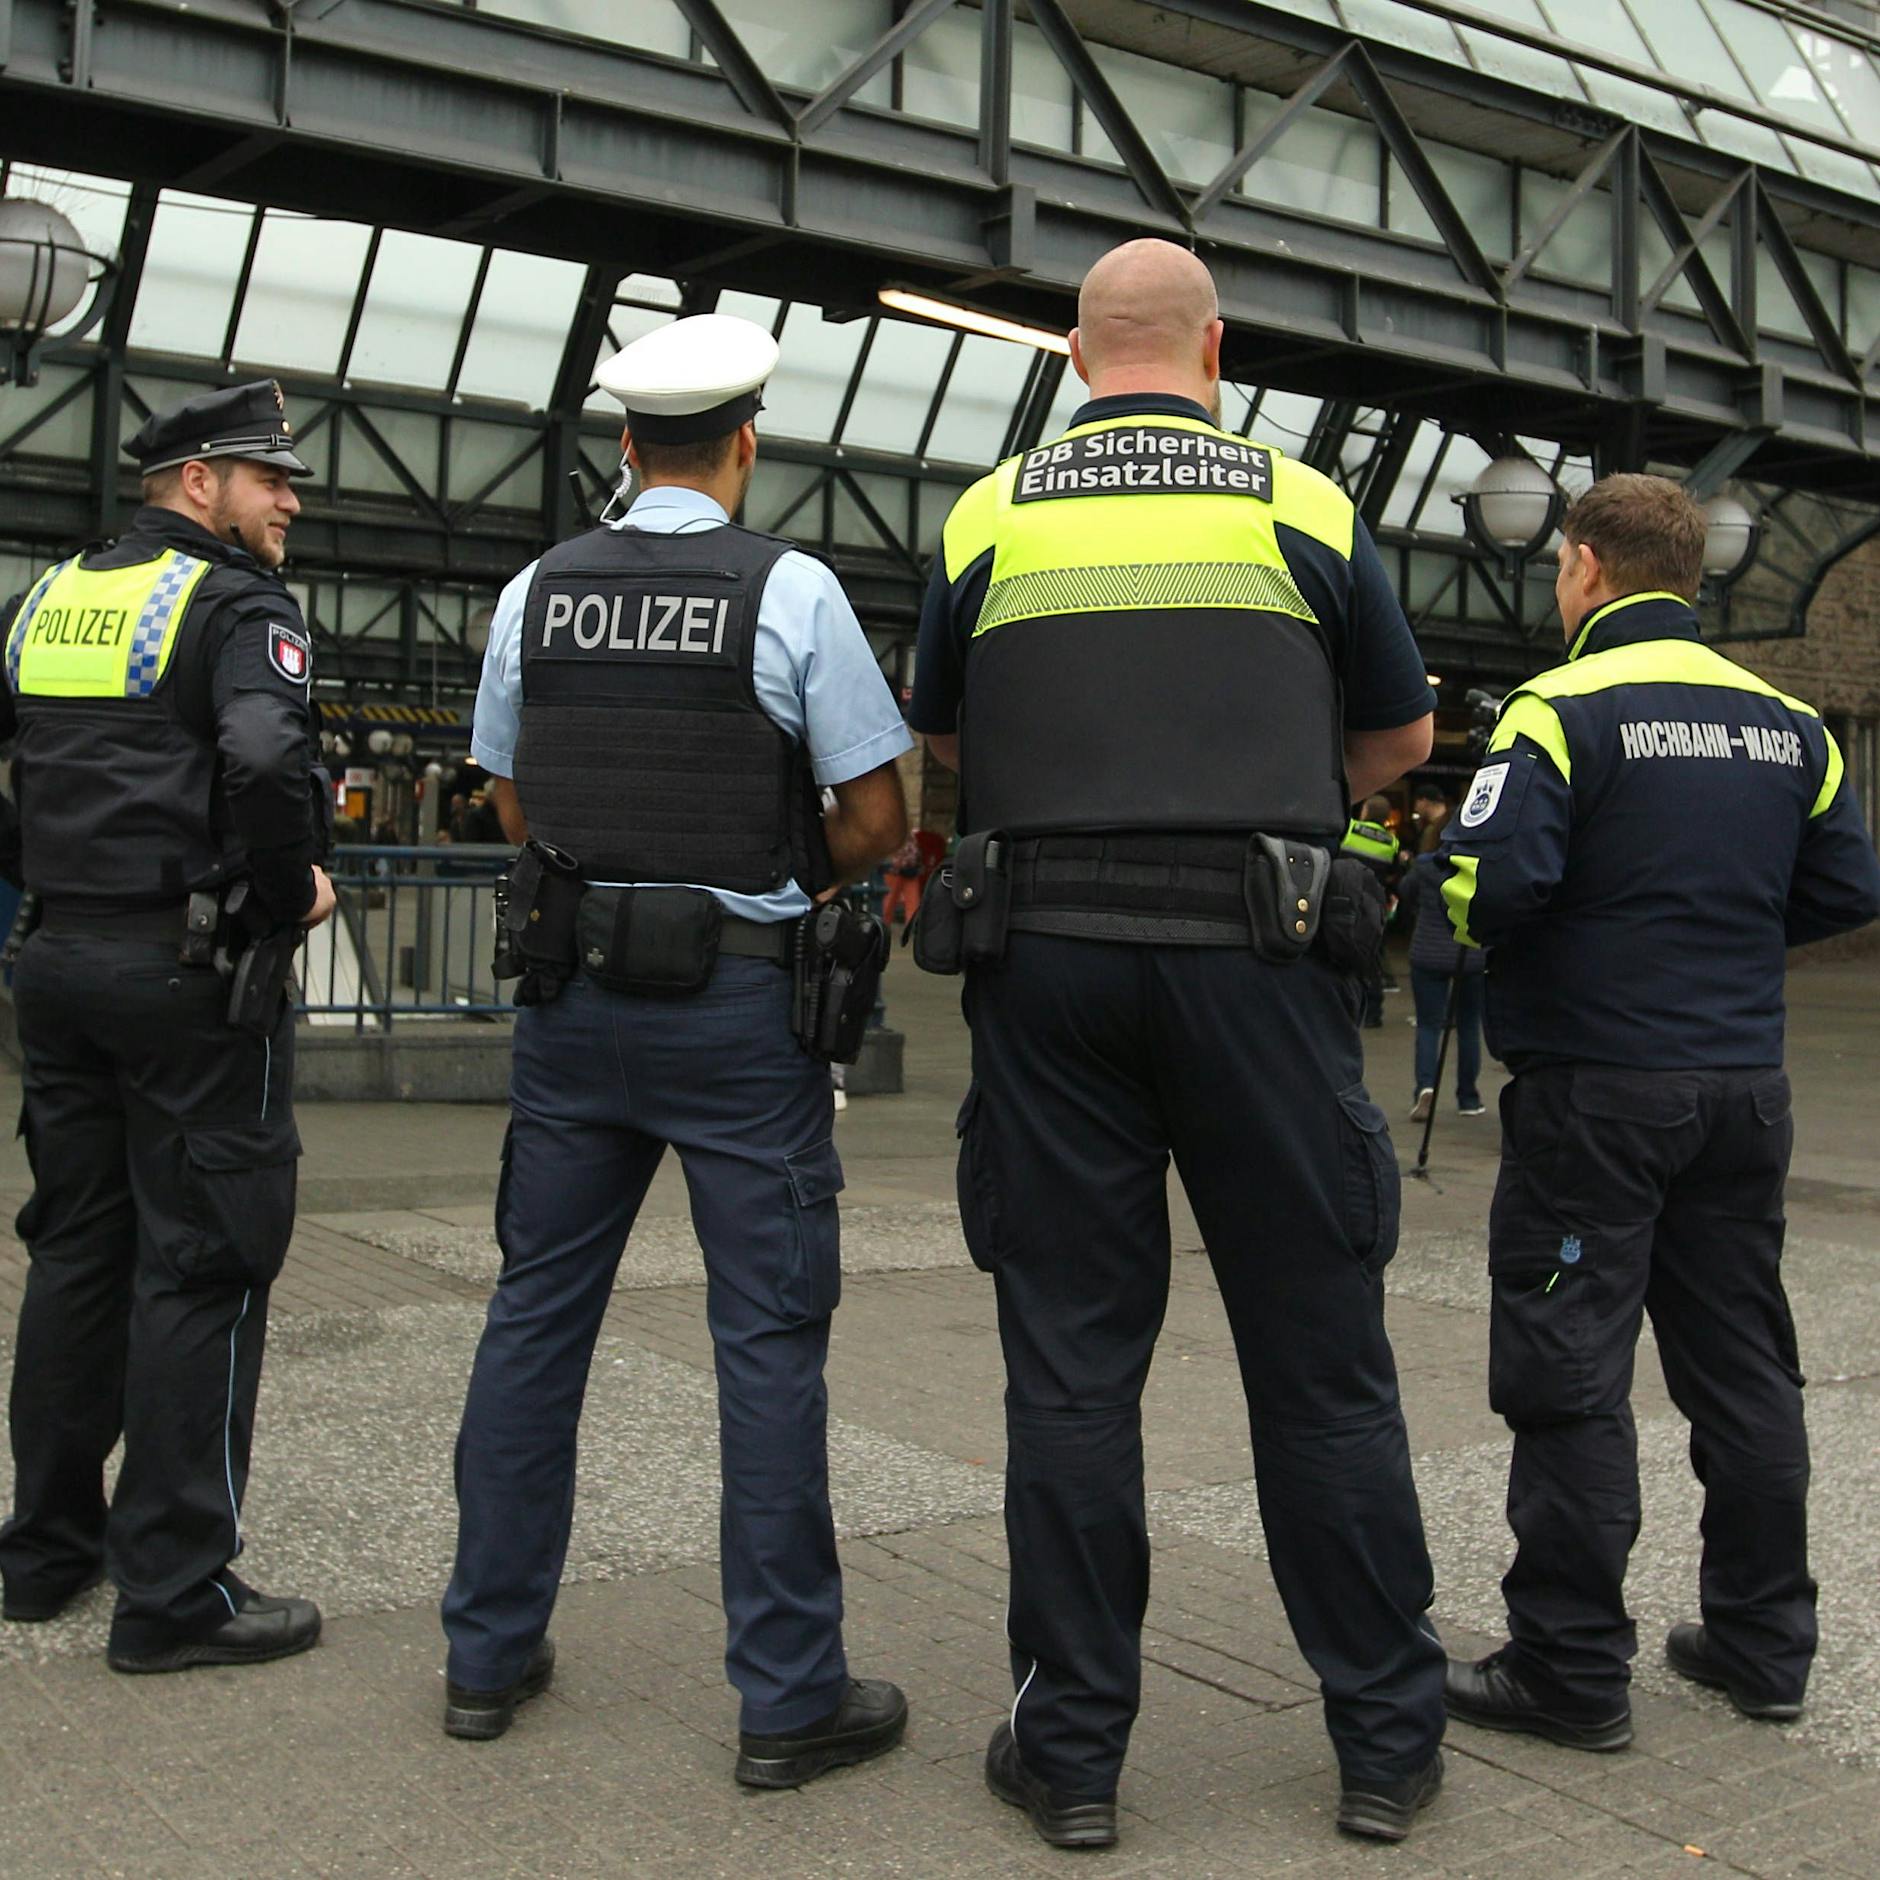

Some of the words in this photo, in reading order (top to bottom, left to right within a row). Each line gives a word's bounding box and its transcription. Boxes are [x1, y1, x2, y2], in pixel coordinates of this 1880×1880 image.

[1026, 442, 1073, 470] DB
[1085, 429, 1265, 468] Sicherheit
[1020, 457, 1267, 495] Einsatzleiter
[32, 608, 128, 646] POLIZEI
[272, 628, 306, 650] POLIZ
[542, 593, 729, 654] POLIZEI
